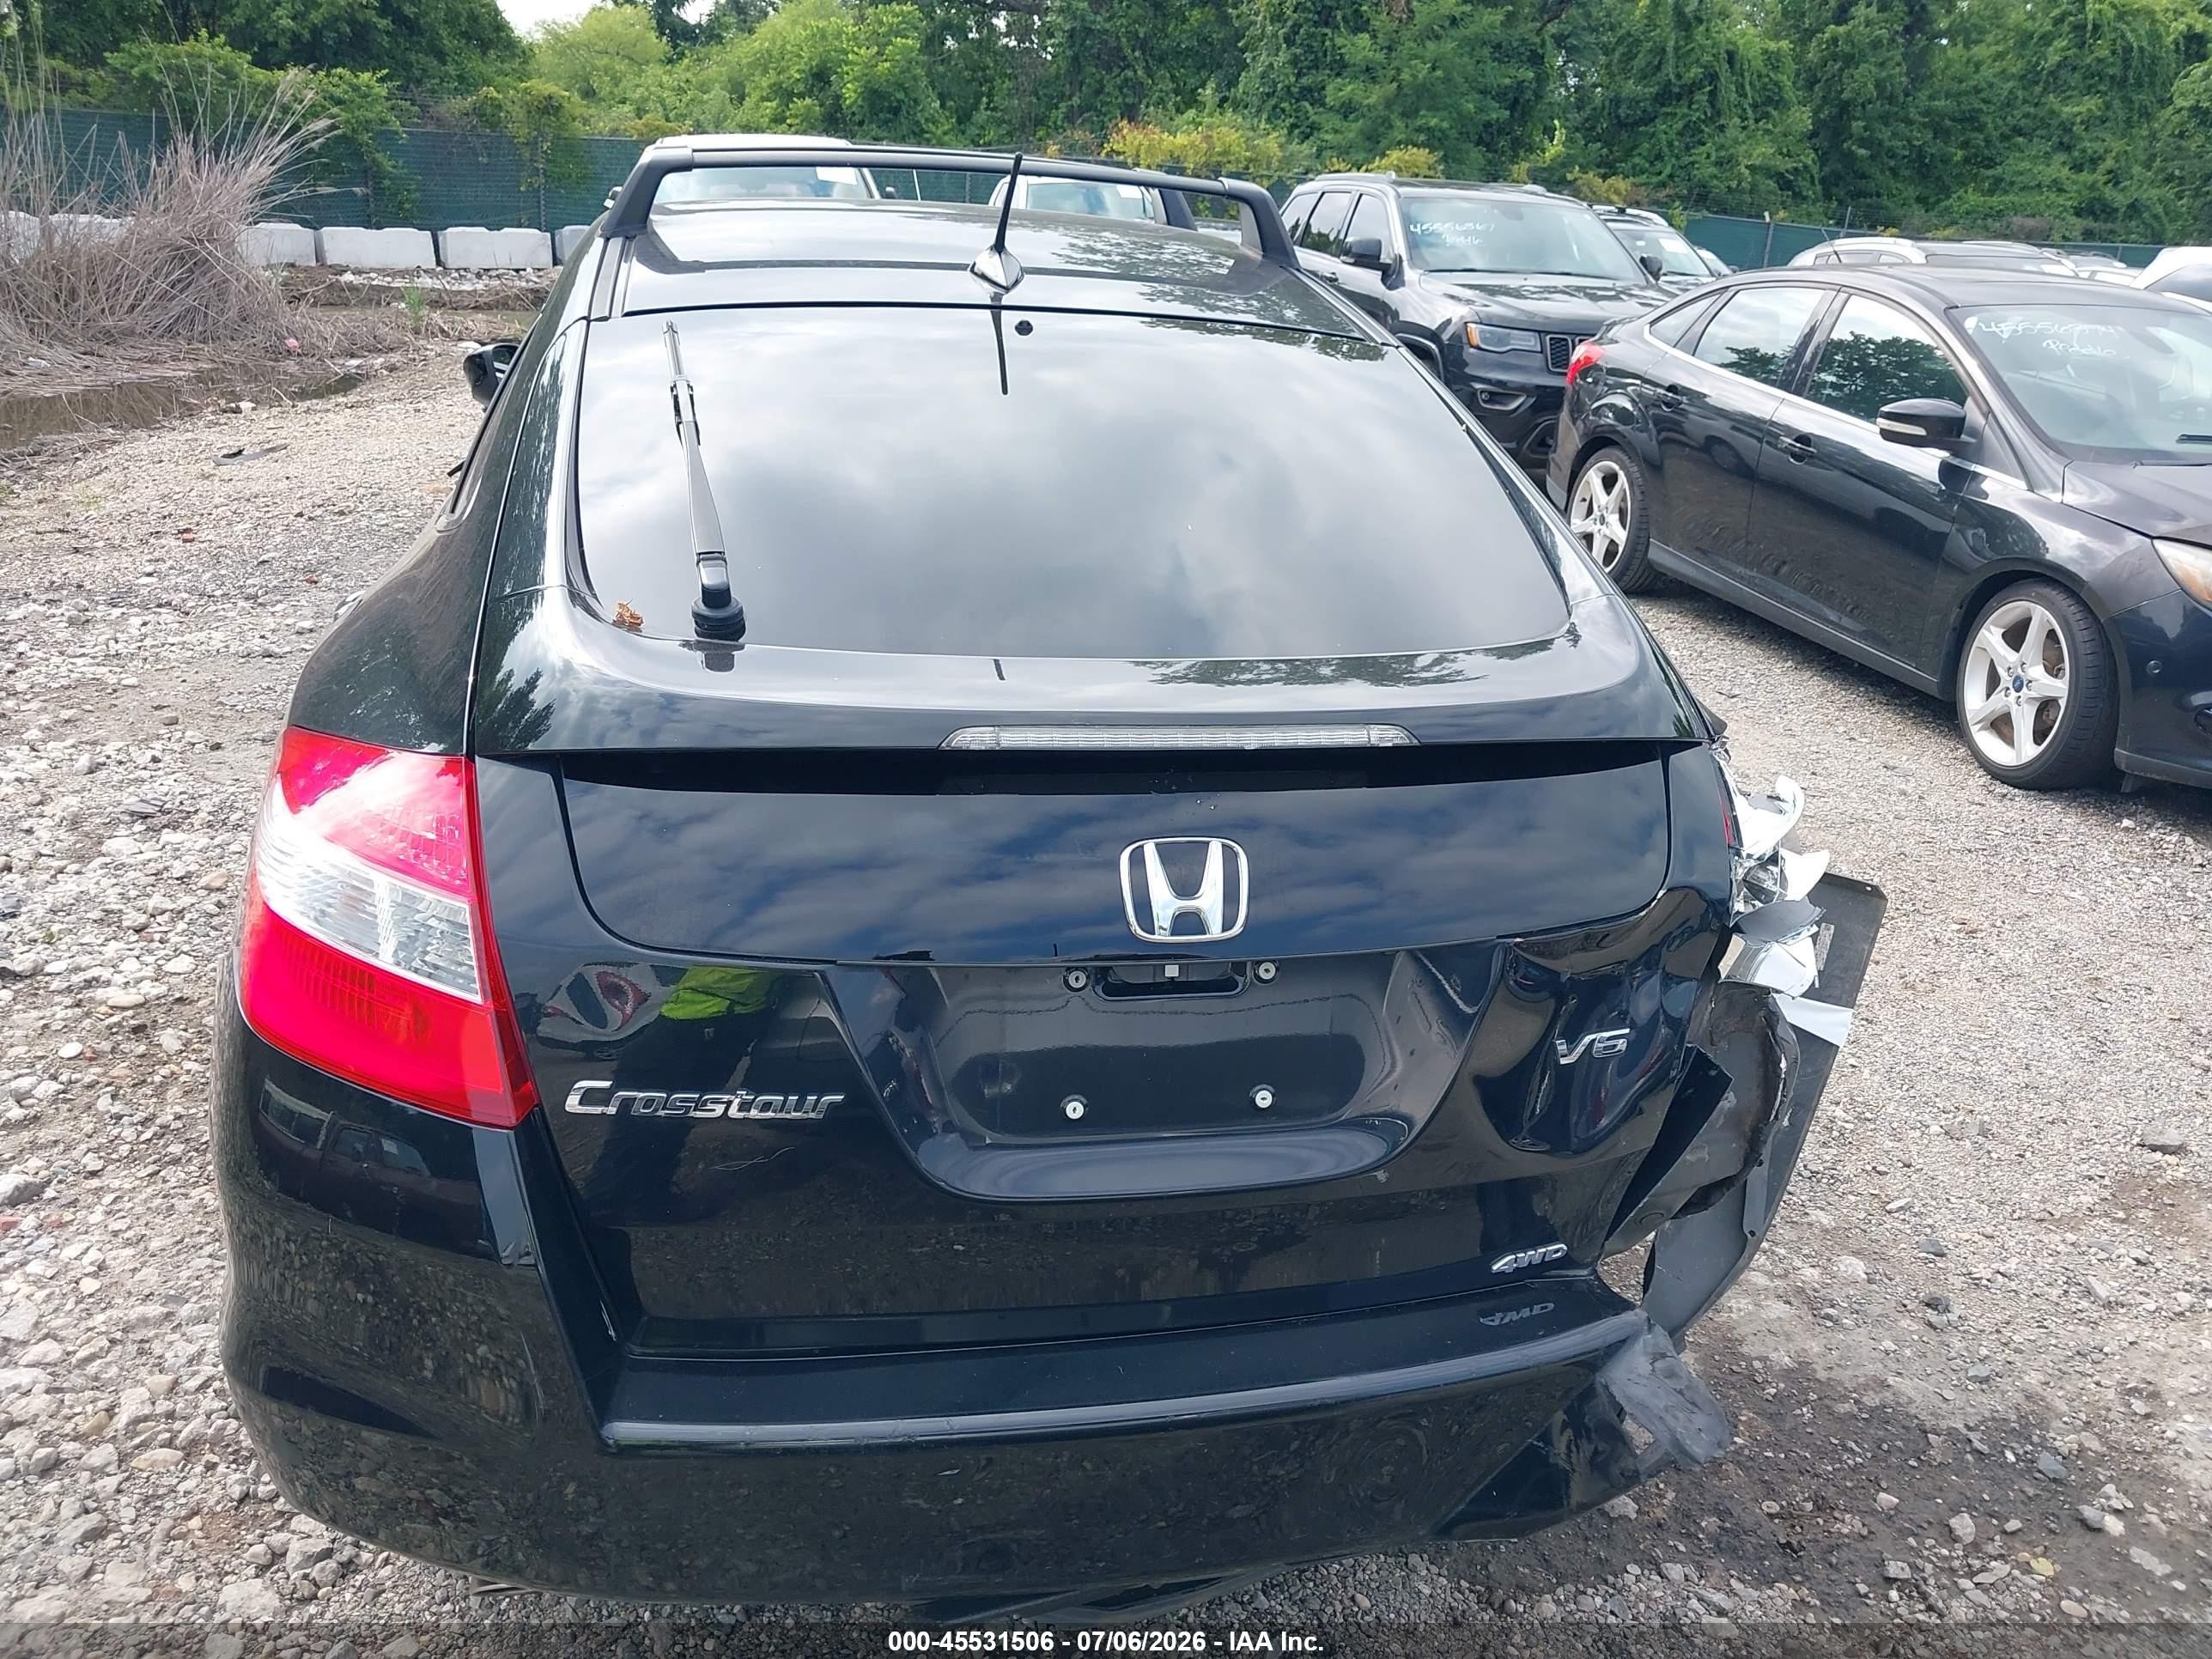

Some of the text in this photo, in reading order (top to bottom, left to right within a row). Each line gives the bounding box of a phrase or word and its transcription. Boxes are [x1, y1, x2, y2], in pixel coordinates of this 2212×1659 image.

[1554, 1028, 1631, 1066] V6
[563, 1079, 846, 1120] Crosstour
[1490, 1242, 1569, 1274] 4WD
